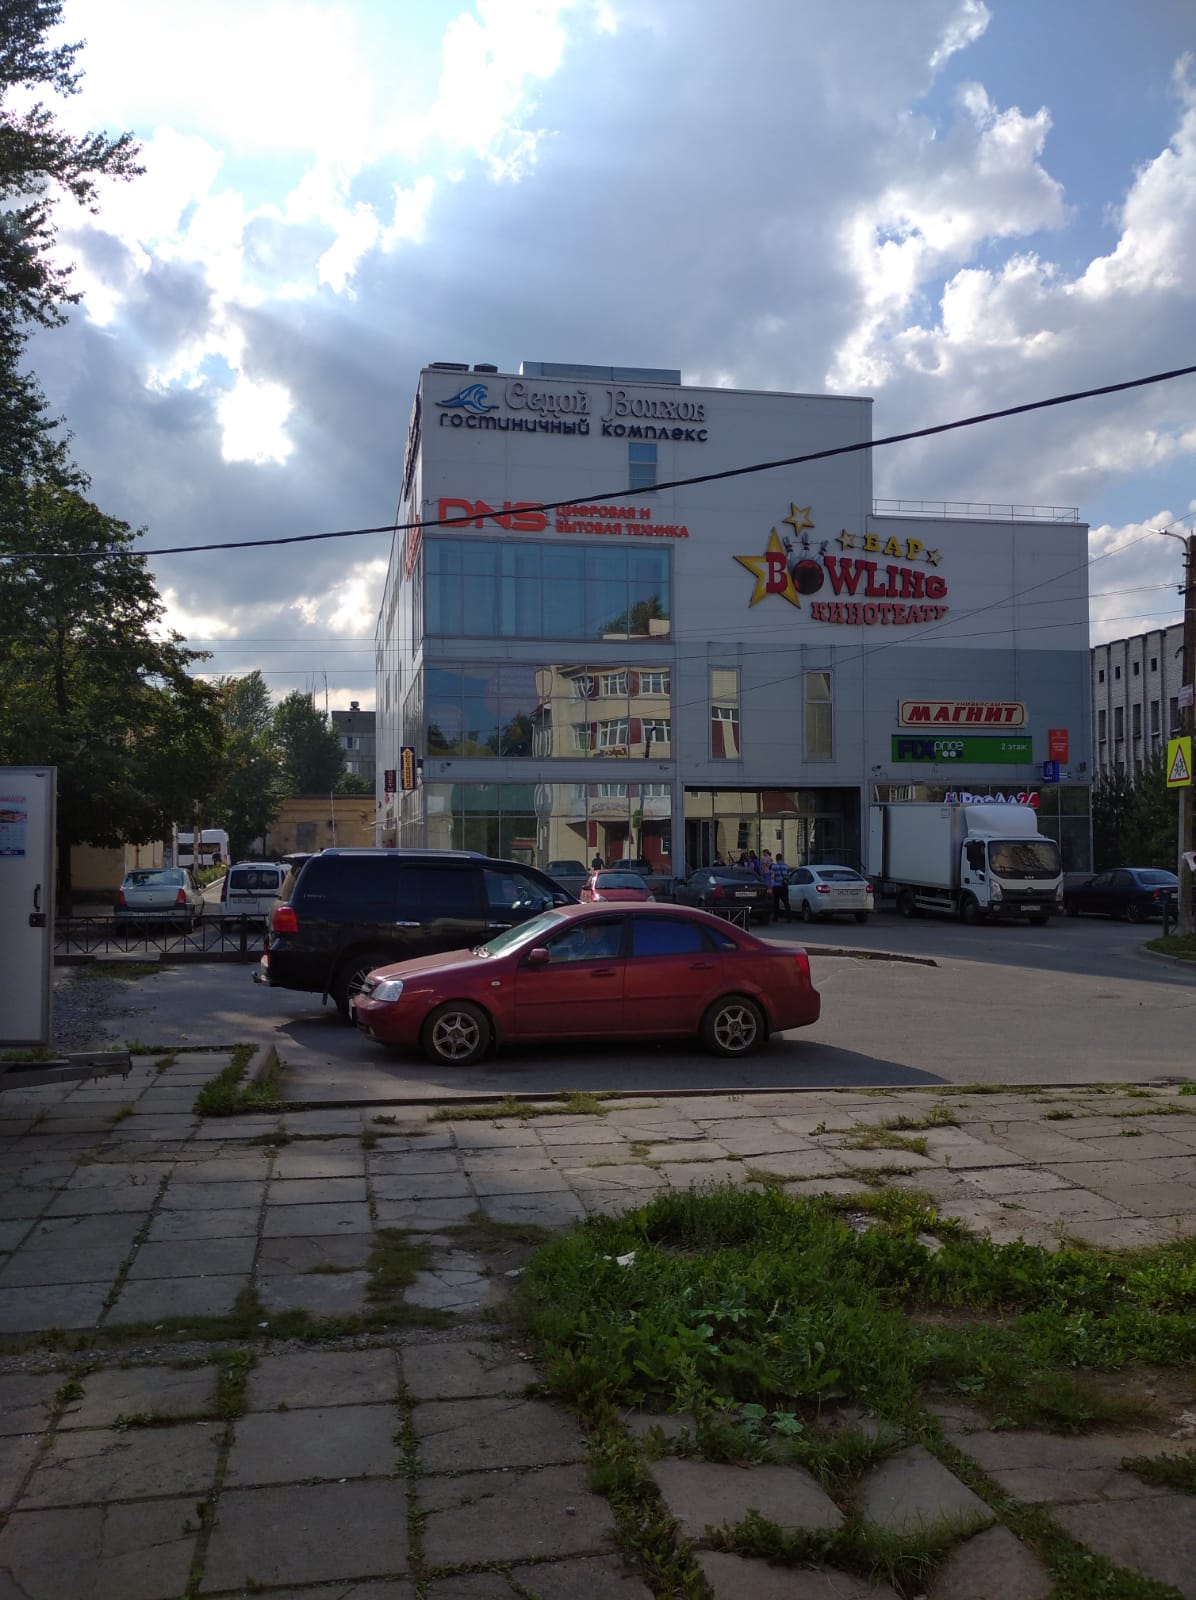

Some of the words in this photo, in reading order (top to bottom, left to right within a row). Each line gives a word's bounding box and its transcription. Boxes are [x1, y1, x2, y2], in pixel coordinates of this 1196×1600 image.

[505, 382, 591, 418] Седой
[601, 390, 705, 422] Волхов
[602, 423, 708, 442] комплекс
[438, 498, 547, 532] DNS
[556, 504, 636, 520] ЦИФРОВАЯ
[638, 507, 651, 520] И
[556, 519, 622, 535] БЫТОВАЯ
[626, 523, 689, 538] ТЕХНИКА
[864, 534, 924, 560] БАР
[765, 551, 948, 599] BOWLING
[811, 602, 949, 625] КИНОТЕАТР
[908, 706, 1018, 722] МАГНИТ
[935, 740, 964, 752] price
